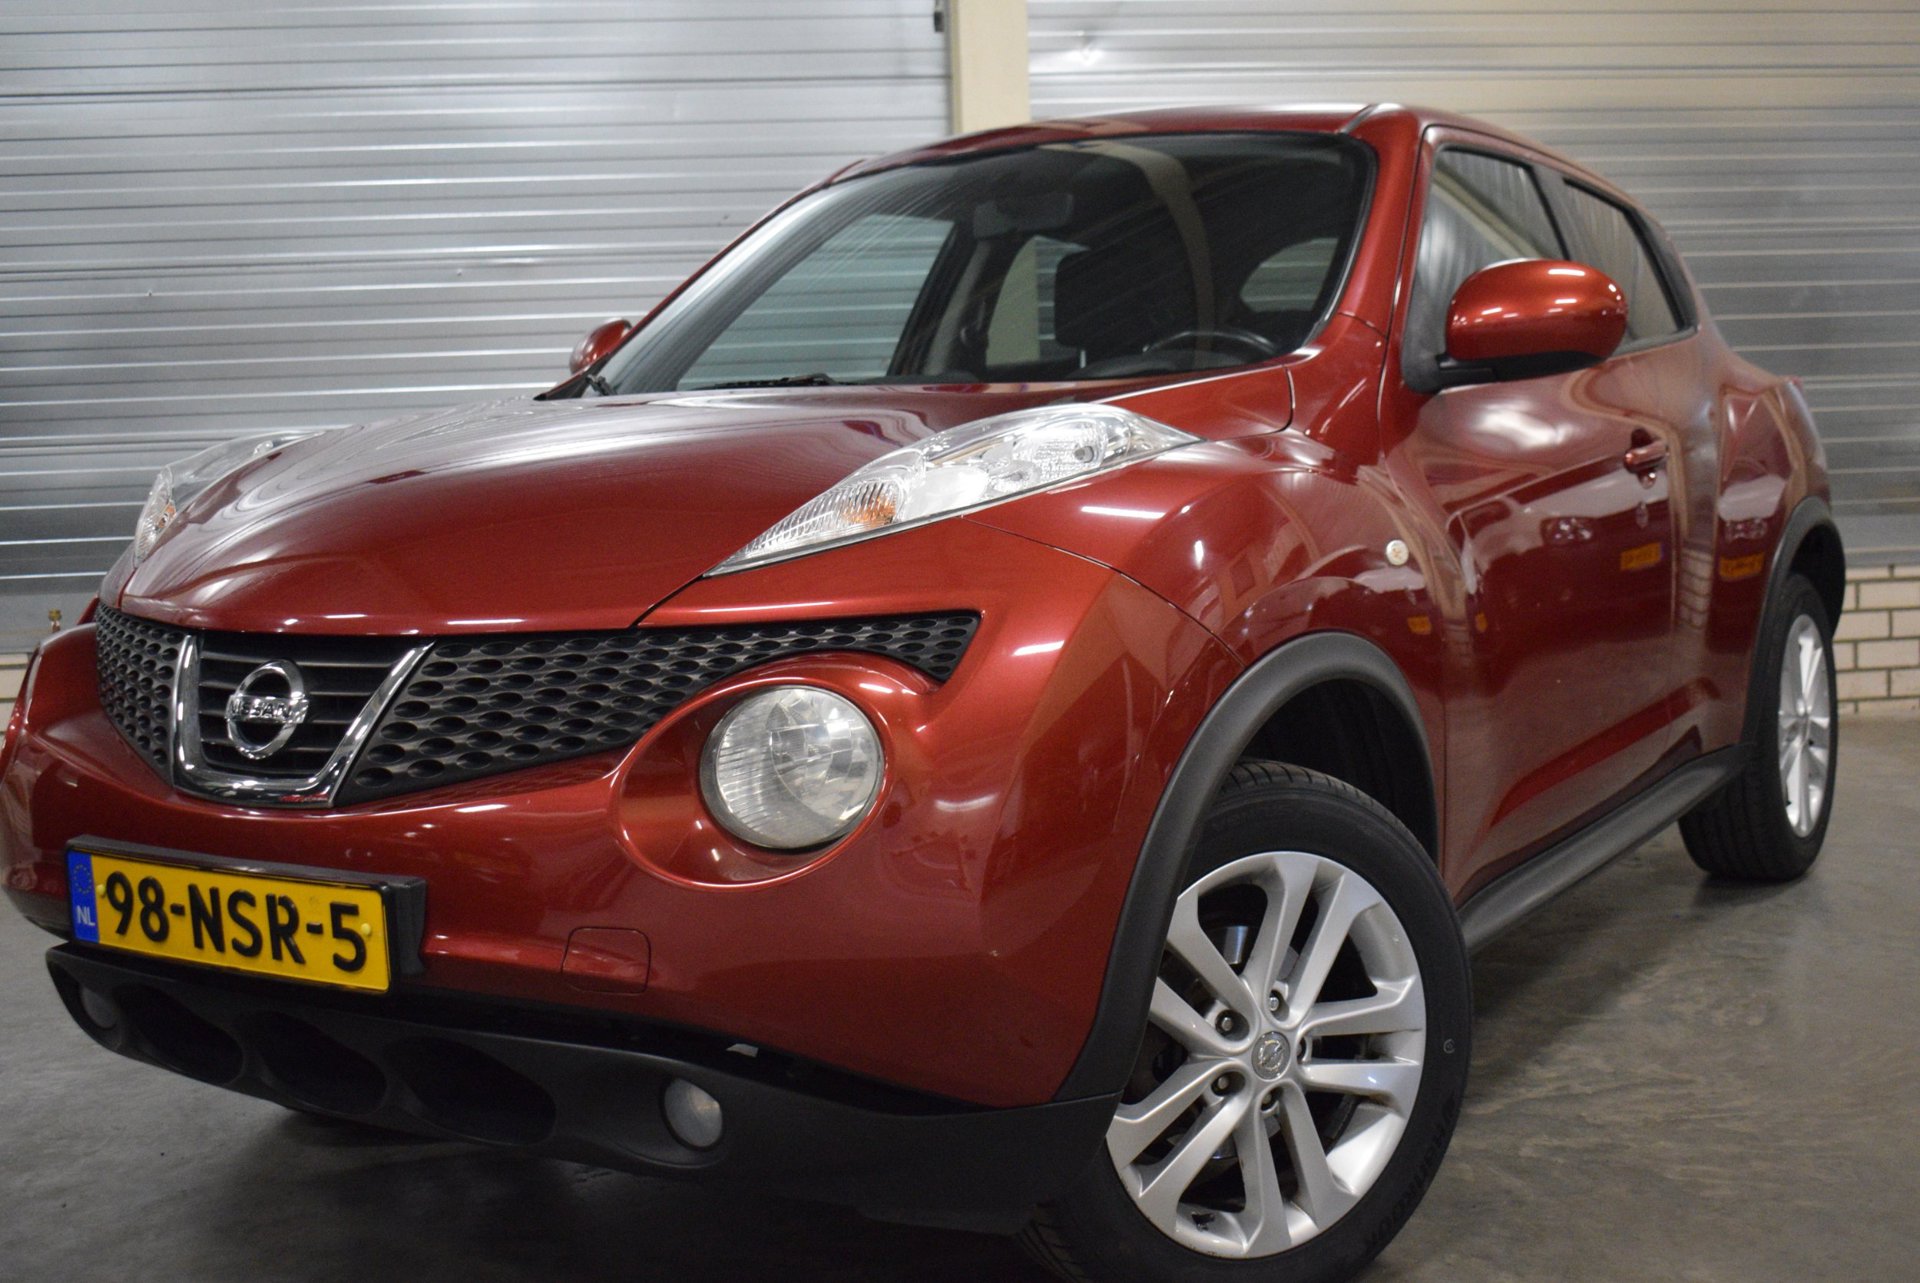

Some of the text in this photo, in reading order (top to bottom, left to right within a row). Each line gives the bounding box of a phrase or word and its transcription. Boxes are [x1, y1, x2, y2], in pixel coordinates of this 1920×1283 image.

[229, 696, 297, 720] NISSAN
[76, 904, 96, 927] NL
[106, 871, 368, 973] 98-NSR-5
